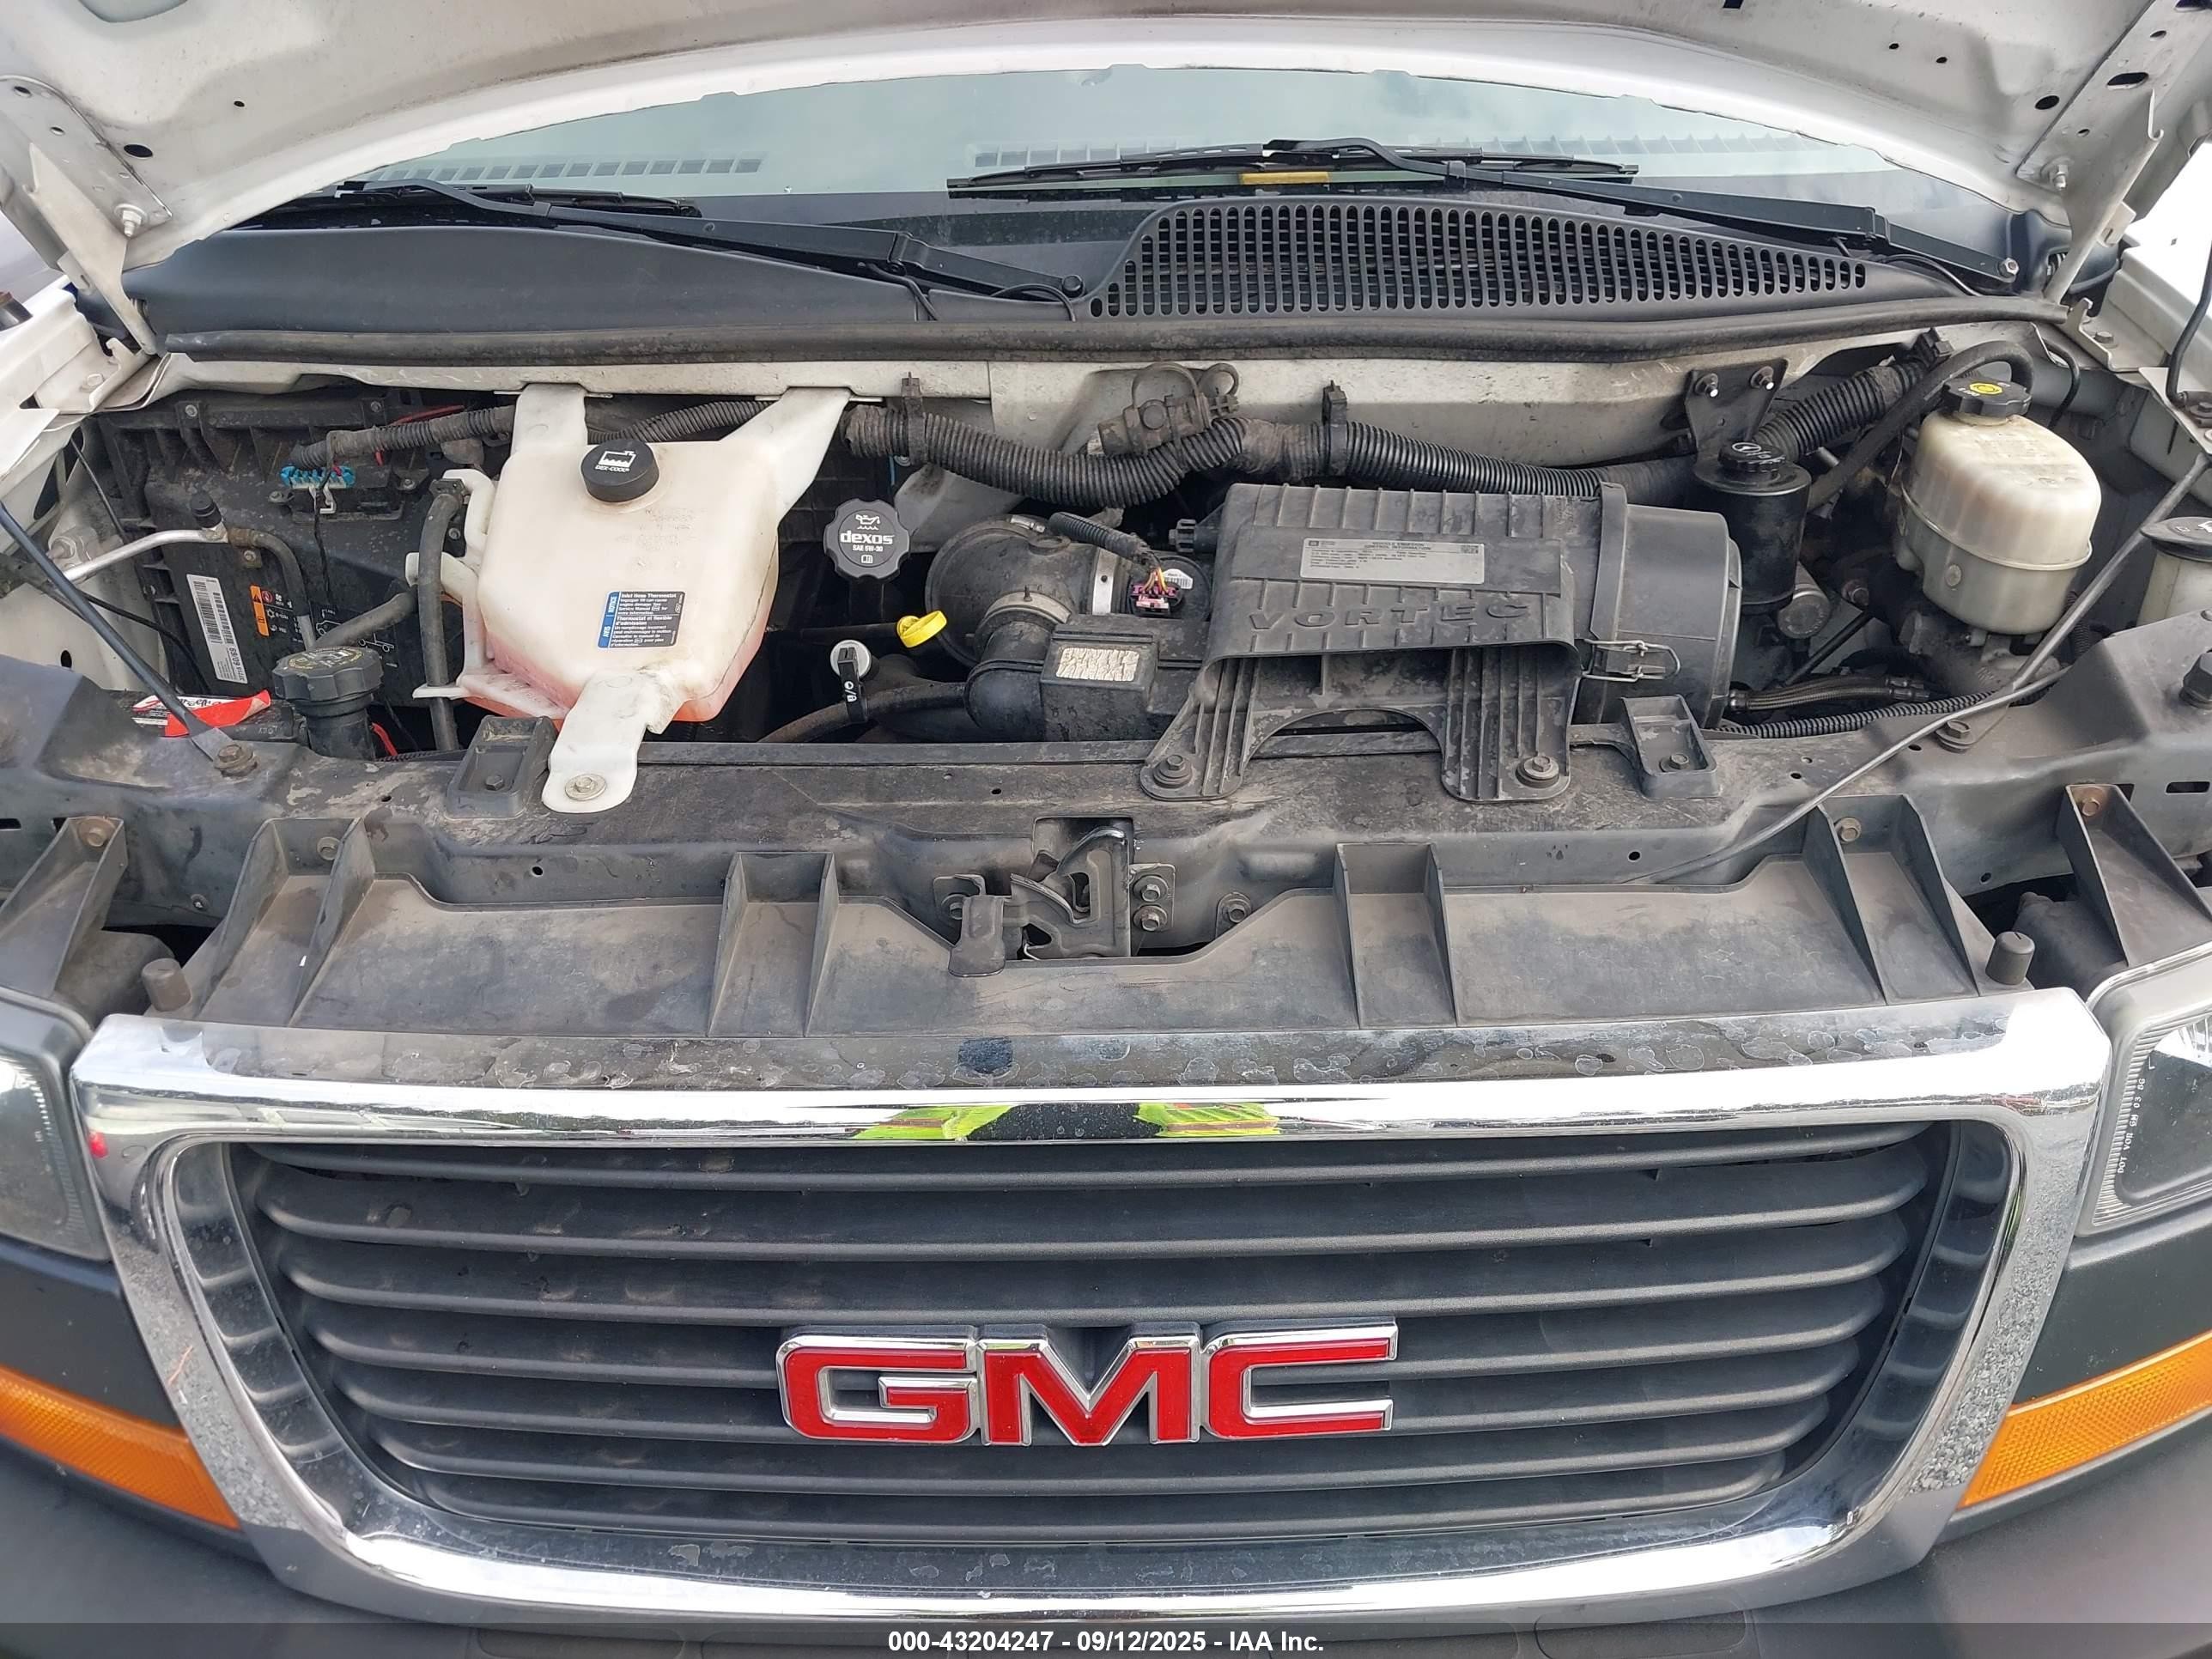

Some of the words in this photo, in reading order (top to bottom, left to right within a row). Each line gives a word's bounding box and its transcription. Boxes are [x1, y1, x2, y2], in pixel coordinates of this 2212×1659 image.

[840, 530, 895, 545] dexos
[608, 596, 617, 613] NOTICE
[1249, 604, 1528, 629] VORTEC
[603, 626, 611, 637] AVIS
[2118, 1156, 2127, 1174] DOT
[2134, 1096, 2142, 1108] 03
[775, 1316, 1398, 1447] GMC
